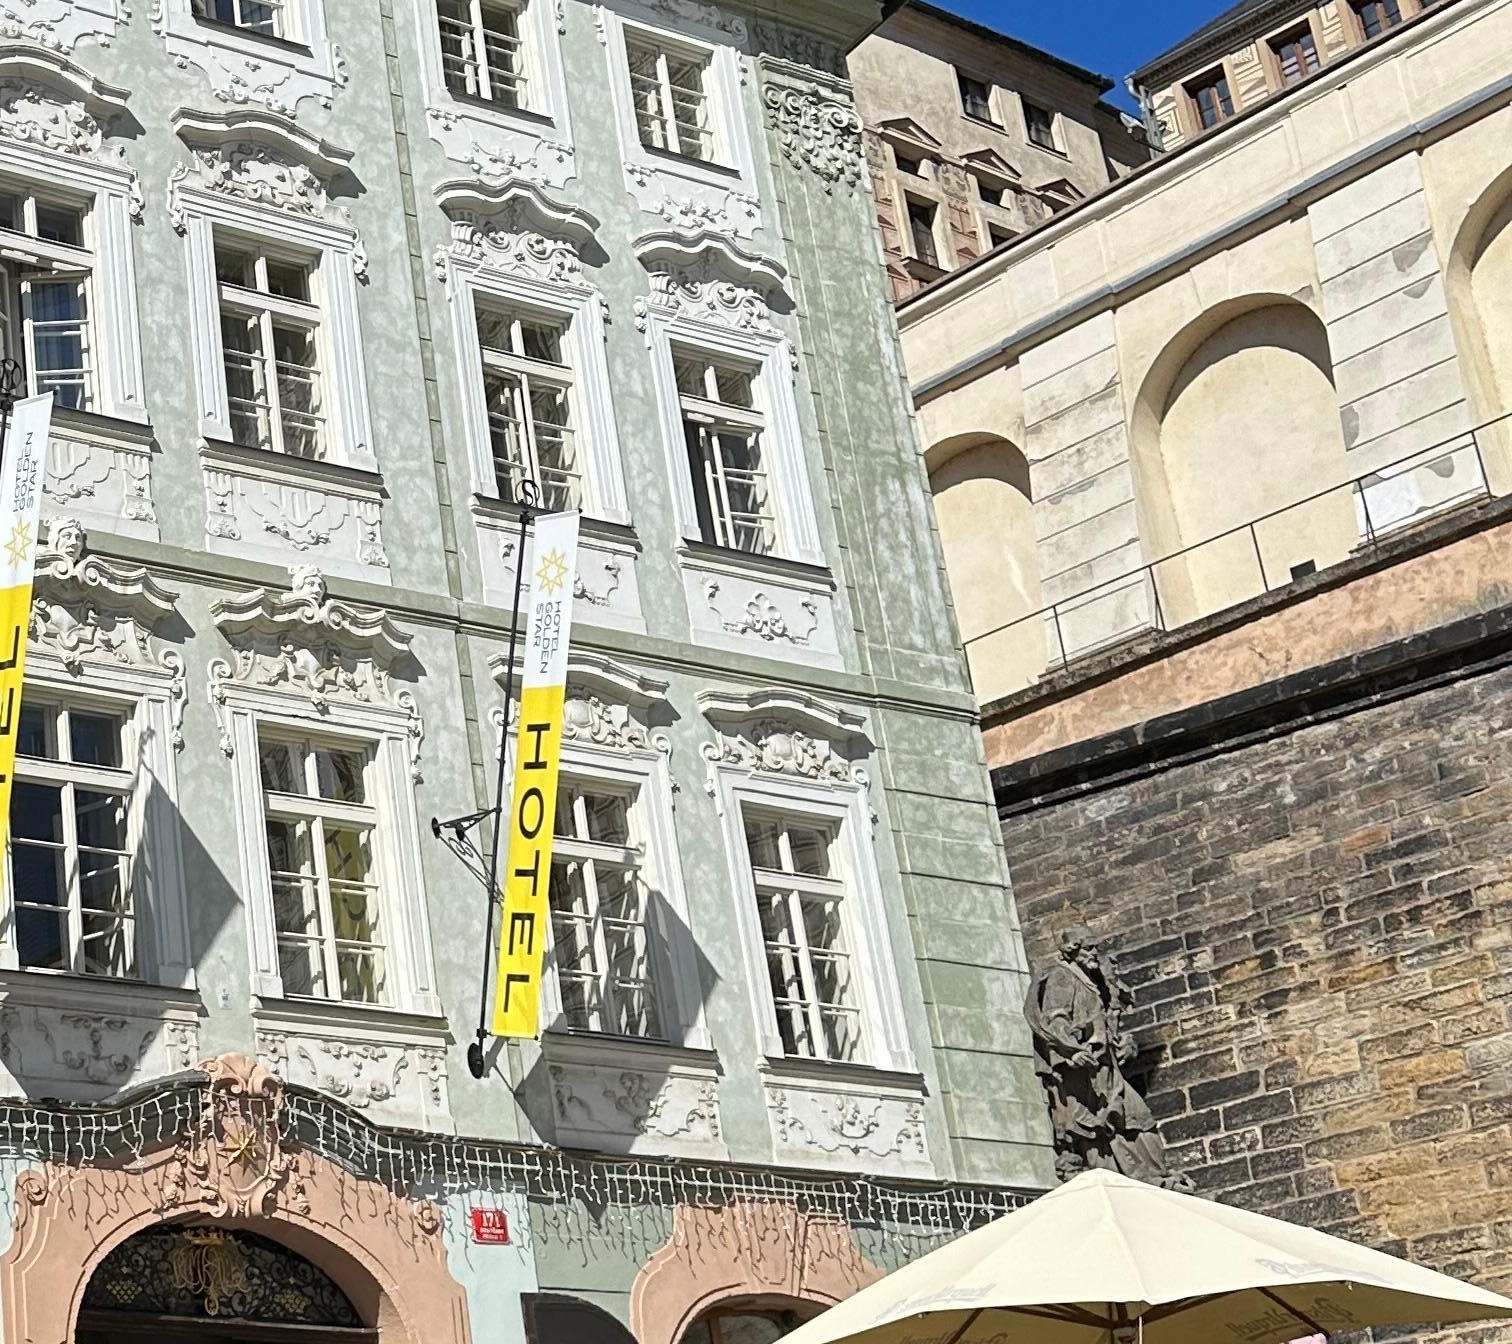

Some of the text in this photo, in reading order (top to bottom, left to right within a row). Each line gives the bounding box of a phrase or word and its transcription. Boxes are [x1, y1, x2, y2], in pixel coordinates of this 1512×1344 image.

[19, 432, 33, 511] GOLDEN
[27, 459, 38, 509] STAR
[533, 603, 544, 648] STAR
[540, 601, 553, 674] GOLDEN
[550, 601, 563, 660] HOTEL
[503, 722, 551, 1014] HOTEL
